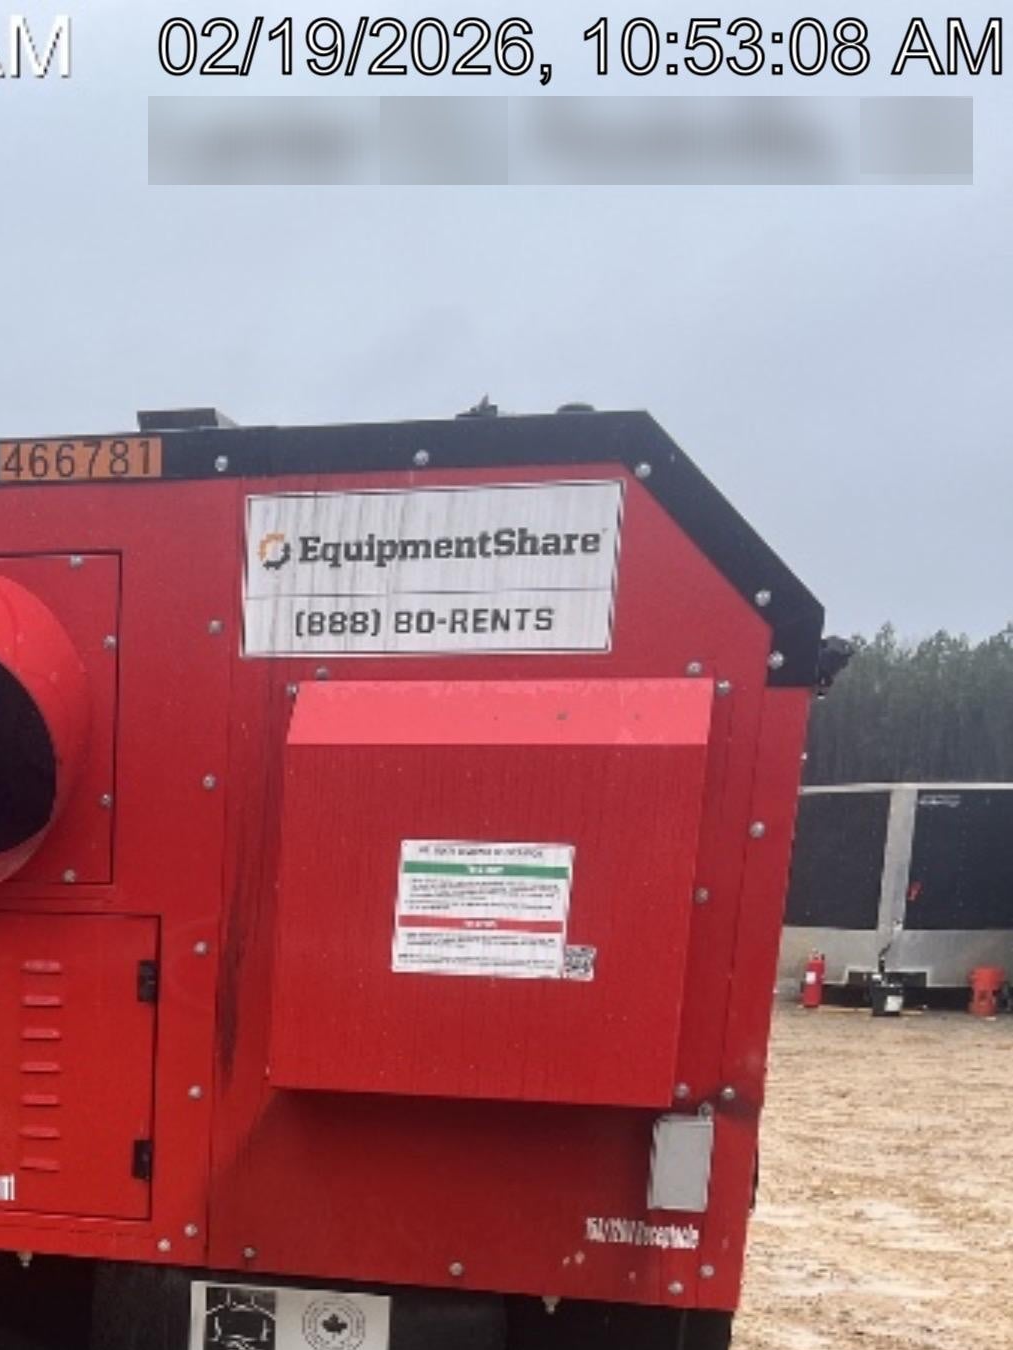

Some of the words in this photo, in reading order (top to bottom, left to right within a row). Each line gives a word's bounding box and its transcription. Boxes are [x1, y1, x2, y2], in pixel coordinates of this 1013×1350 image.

[1, 439, 151, 478] 466781
[299, 527, 601, 568] EquipmentShare
[294, 609, 381, 637] (888)
[394, 608, 555, 635] 80-RENTS
